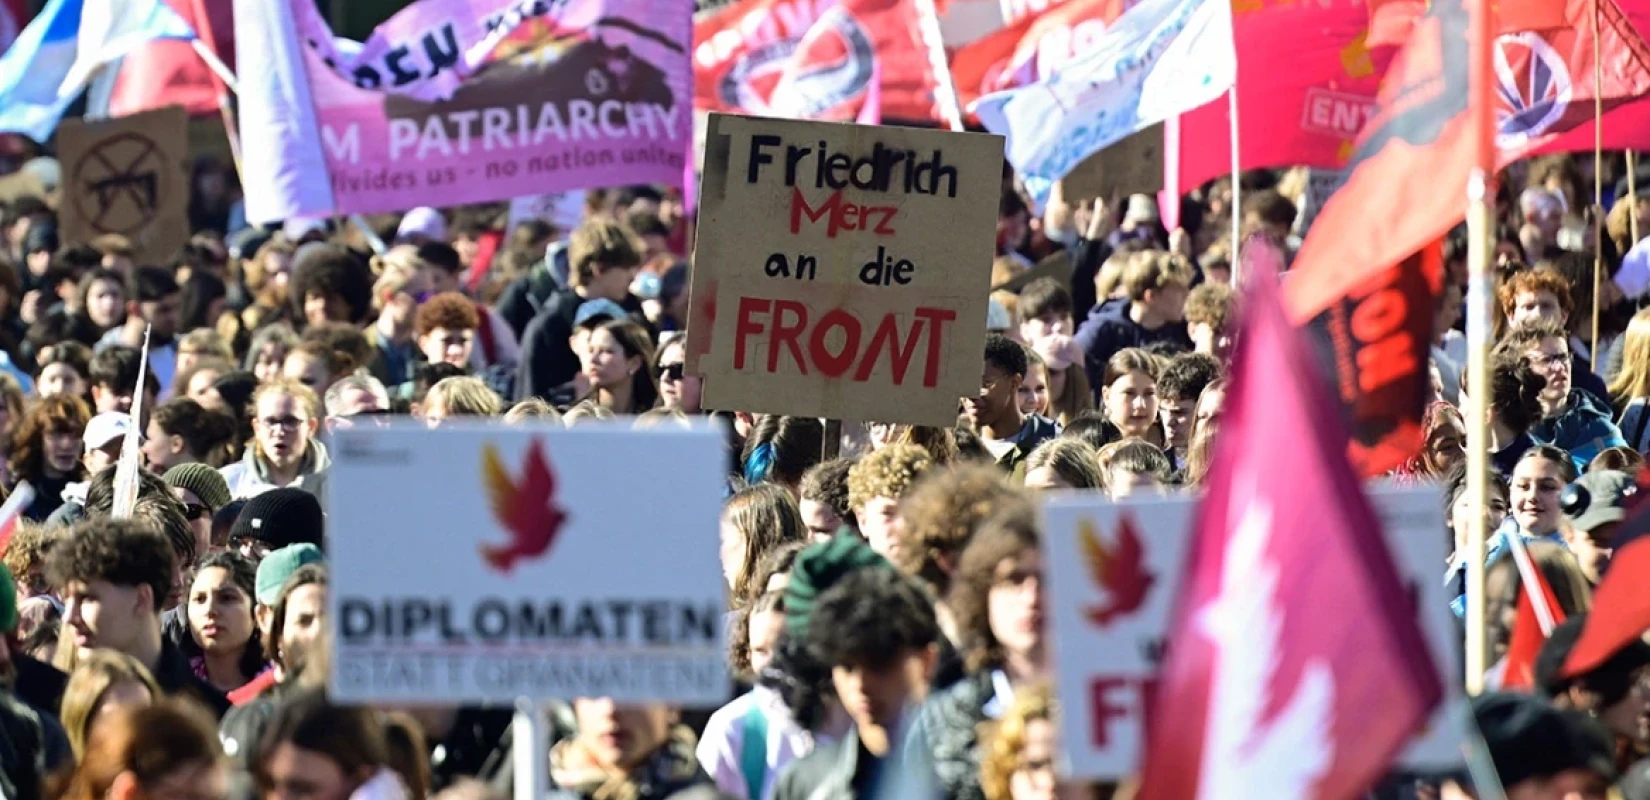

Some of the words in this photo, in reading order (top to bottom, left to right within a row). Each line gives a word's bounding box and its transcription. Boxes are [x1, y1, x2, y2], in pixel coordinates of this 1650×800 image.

[388, 98, 680, 162] PATRIARCHY
[426, 166, 458, 185] us
[484, 159, 519, 179] no
[527, 147, 615, 174] nation
[747, 134, 958, 198] Friedrich
[789, 186, 899, 239] Merz
[764, 252, 817, 280] an
[858, 245, 915, 287] die
[733, 296, 957, 389] FRONT
[338, 597, 719, 644] DIPLOMATEN
[338, 652, 467, 694] STATT
